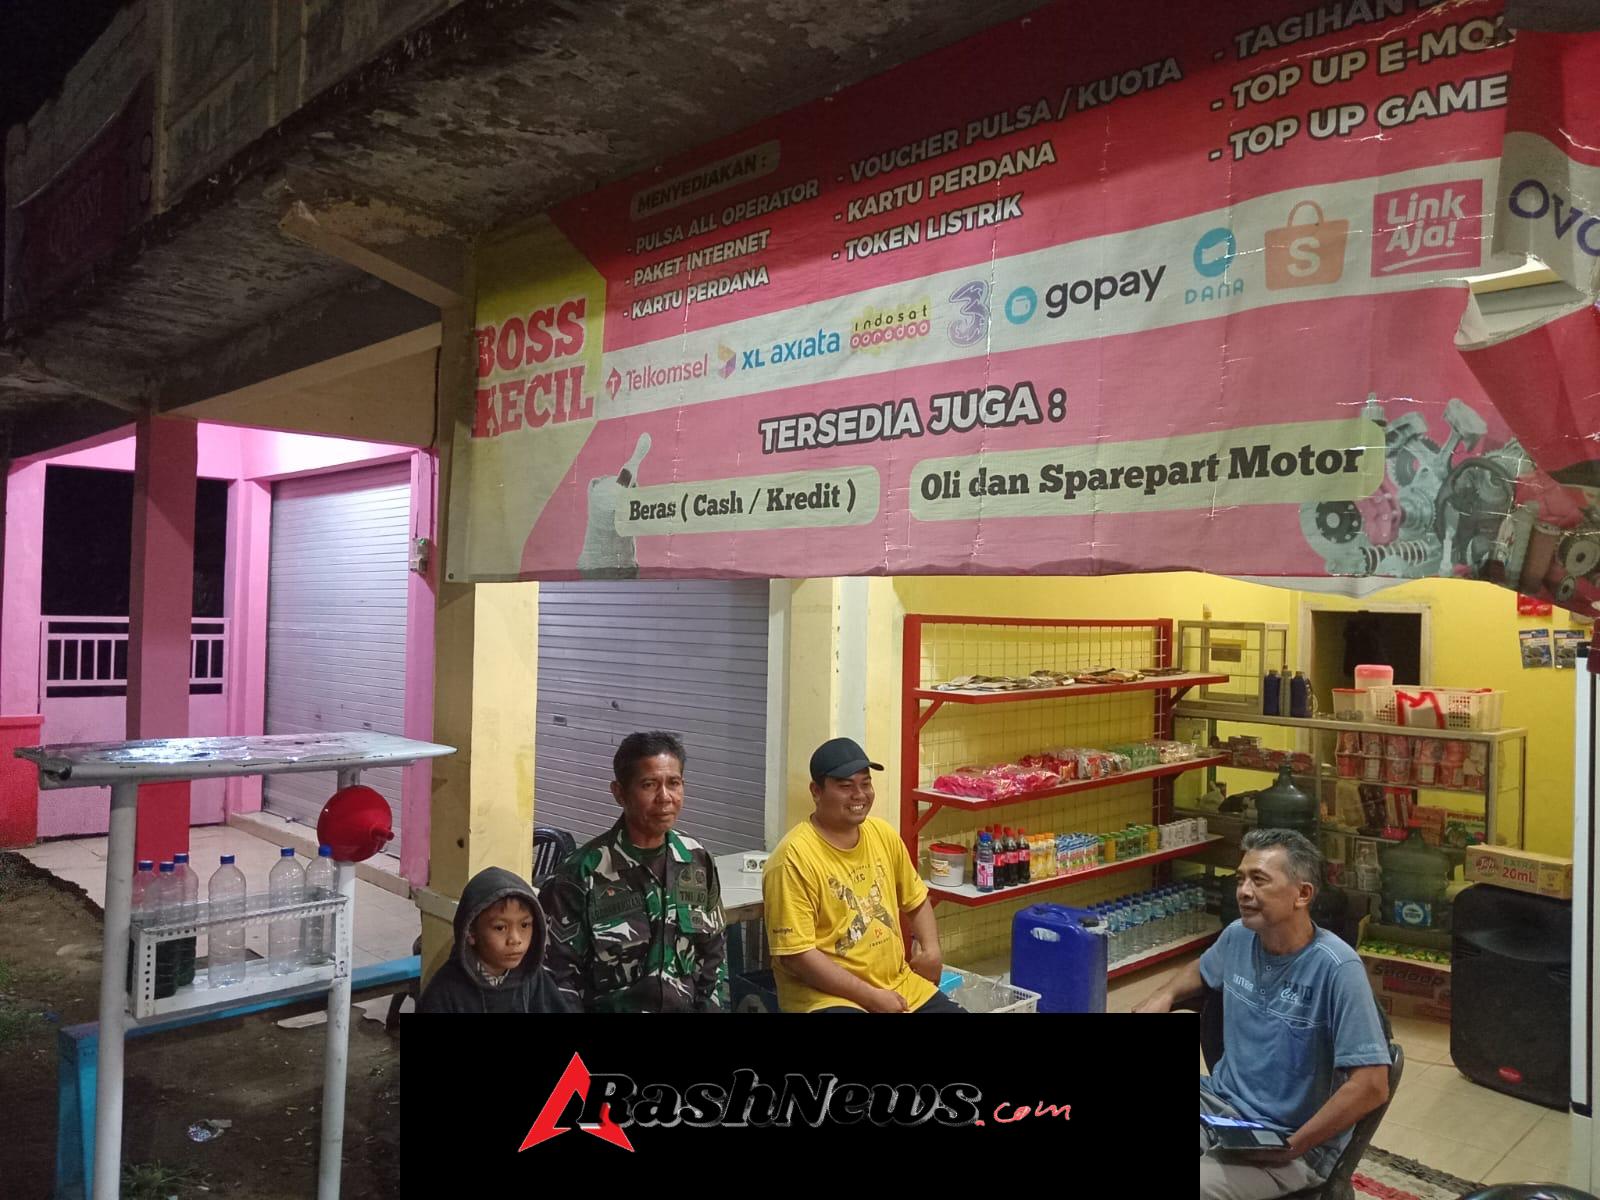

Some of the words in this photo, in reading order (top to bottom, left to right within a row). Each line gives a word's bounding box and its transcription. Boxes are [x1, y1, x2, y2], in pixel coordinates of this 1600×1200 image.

[1233, 0, 1402, 58] TAGIHAN
[1232, 66, 1301, 109] TOP
[1310, 50, 1367, 85] UP
[849, 128, 958, 184] VOUCHER
[966, 100, 1051, 145] PULSA
[1077, 57, 1183, 111] KUOTA
[1229, 118, 1298, 160] TOP
[1308, 104, 1366, 138] UP
[1376, 74, 1508, 128] GAME
[637, 153, 757, 212] MENYEDIAKAN
[847, 180, 922, 224] KARTU
[929, 140, 1056, 198] PERDANA
[1387, 189, 1464, 224] Link
[635, 229, 684, 255] PULSA
[688, 219, 718, 238] ALL
[722, 180, 819, 225] OPERATOR
[845, 221, 919, 262] TOKEN
[926, 193, 1024, 241] LISTRIK
[1387, 220, 1456, 258] Aja!
[633, 257, 683, 287] PAKET
[686, 229, 770, 271] INTERNET
[631, 290, 683, 320] KARTU
[686, 266, 770, 302] PERDANA
[1045, 265, 1166, 318] gopay
[474, 298, 586, 377] BOSS
[742, 348, 765, 370] XL
[770, 328, 840, 364] axiata
[851, 320, 930, 349] ooredoo
[626, 353, 708, 391] Telkomsel
[471, 365, 594, 438] KECIL
[759, 396, 922, 455] TERSEDIA
[929, 383, 1042, 434] JUGA
[920, 470, 961, 501] Oli
[968, 467, 1030, 498] dan
[1038, 453, 1220, 498] Sparepart
[1227, 444, 1365, 481] Motor
[629, 499, 676, 521] Beras
[1501, 866, 1536, 884] 20mL
